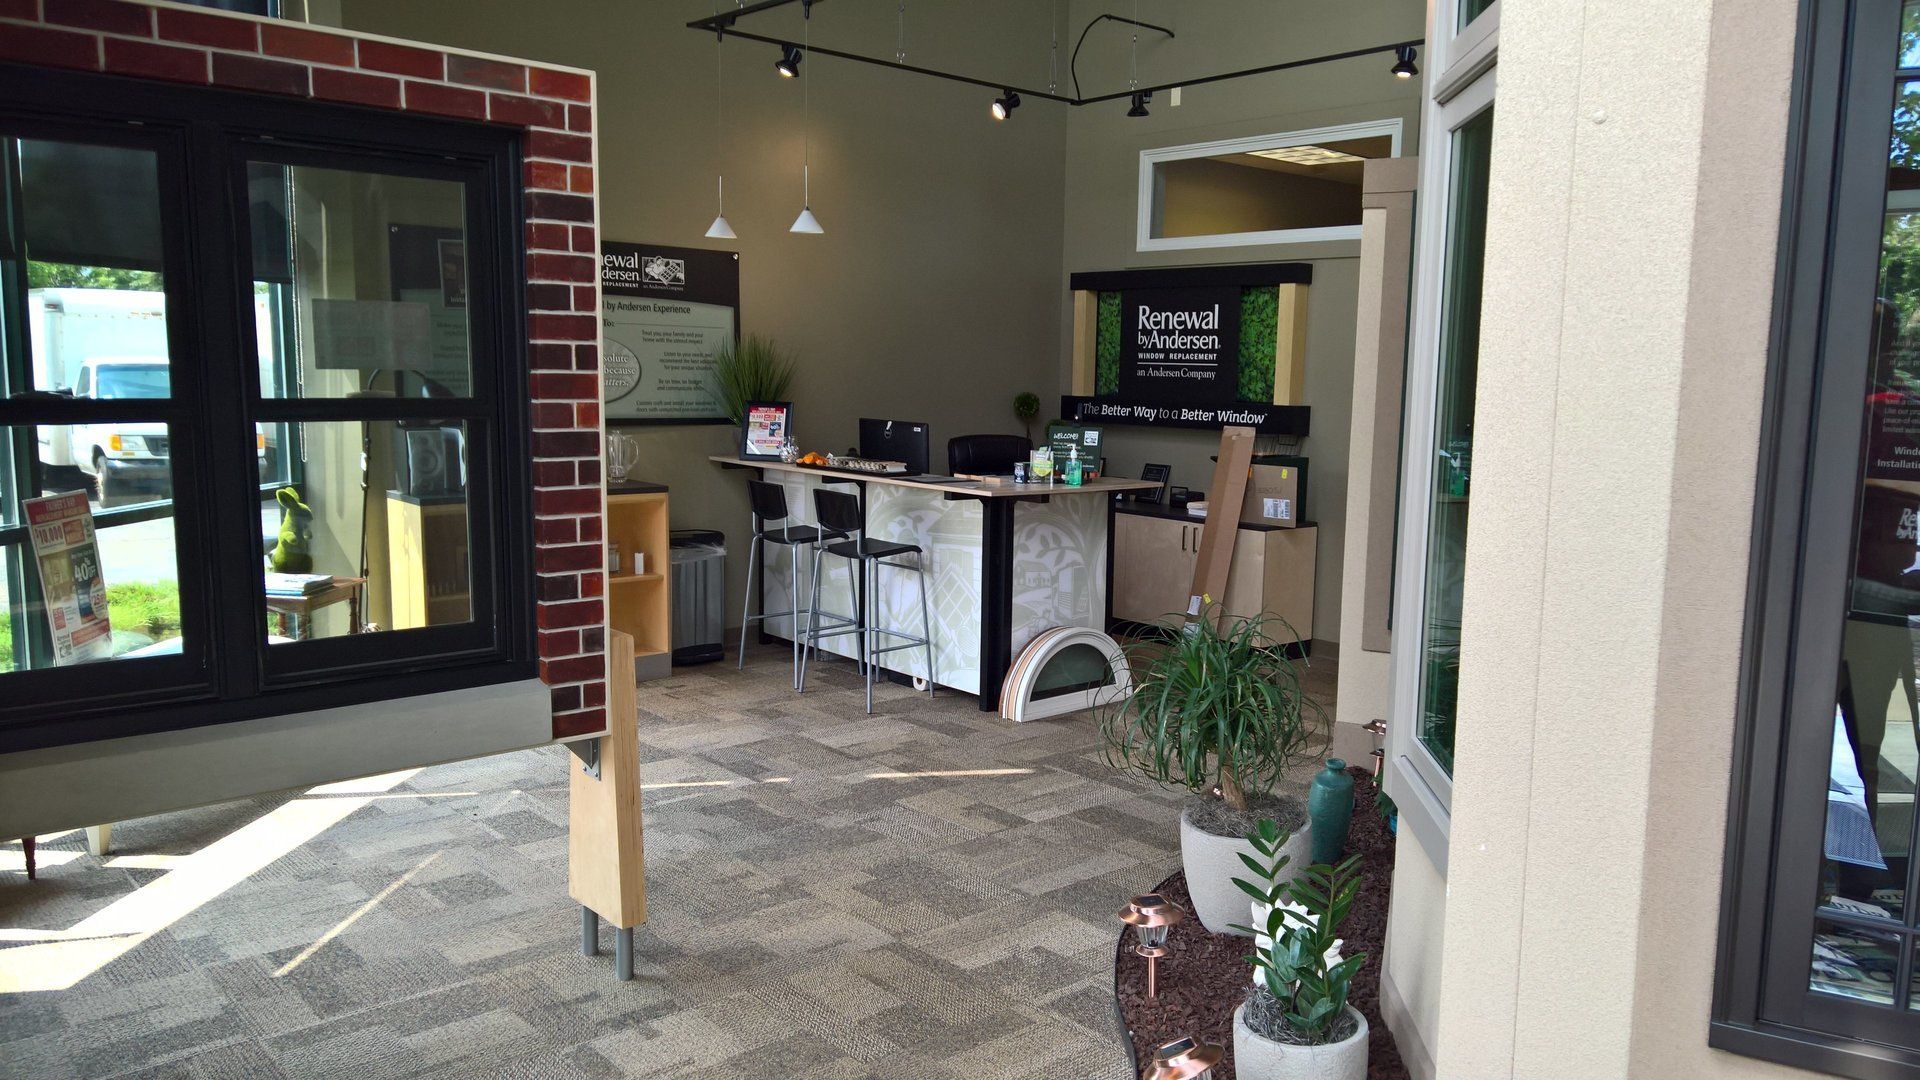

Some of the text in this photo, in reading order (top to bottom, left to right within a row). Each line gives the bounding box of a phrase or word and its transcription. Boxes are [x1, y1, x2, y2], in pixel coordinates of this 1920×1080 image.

[606, 301, 691, 315] by Andersen Experience
[1138, 304, 1219, 330] Renewal
[1148, 330, 1219, 350] Andersen
[1138, 352, 1218, 361] WINDOW REPLACEMENT
[1137, 366, 1217, 381] an Andersen Company
[1083, 403, 1265, 424] The Better Way to a Better Window
